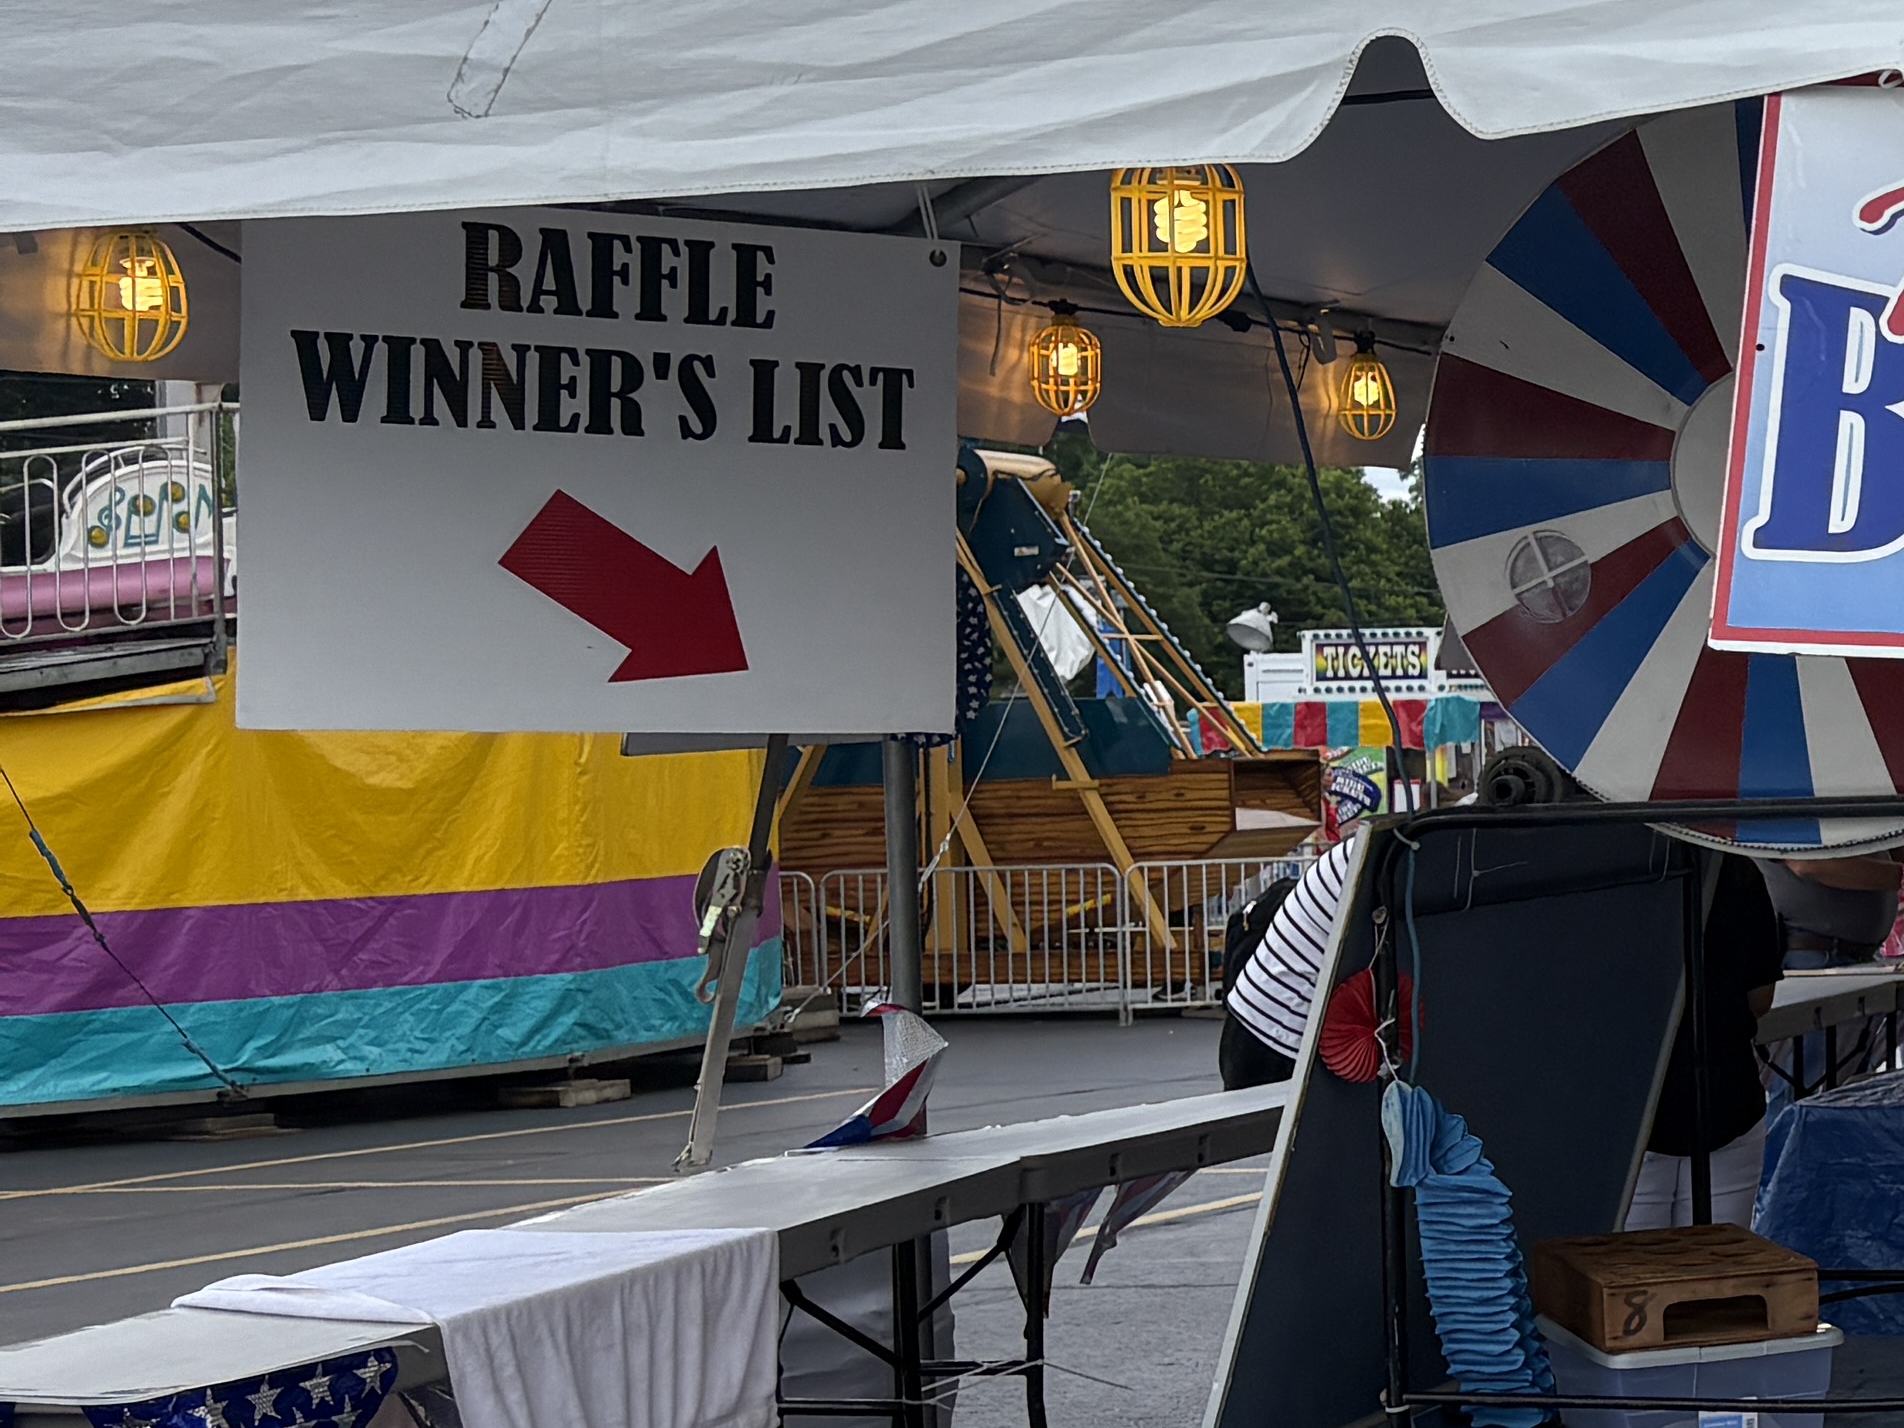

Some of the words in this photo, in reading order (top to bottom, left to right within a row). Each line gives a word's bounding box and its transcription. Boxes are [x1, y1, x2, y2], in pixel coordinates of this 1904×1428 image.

[459, 221, 777, 330] RAFFLE
[290, 329, 718, 442] WINNER'S
[747, 358, 917, 452] LIST
[1323, 644, 1421, 678] TICKETS
[1623, 1290, 1651, 1337] 8
